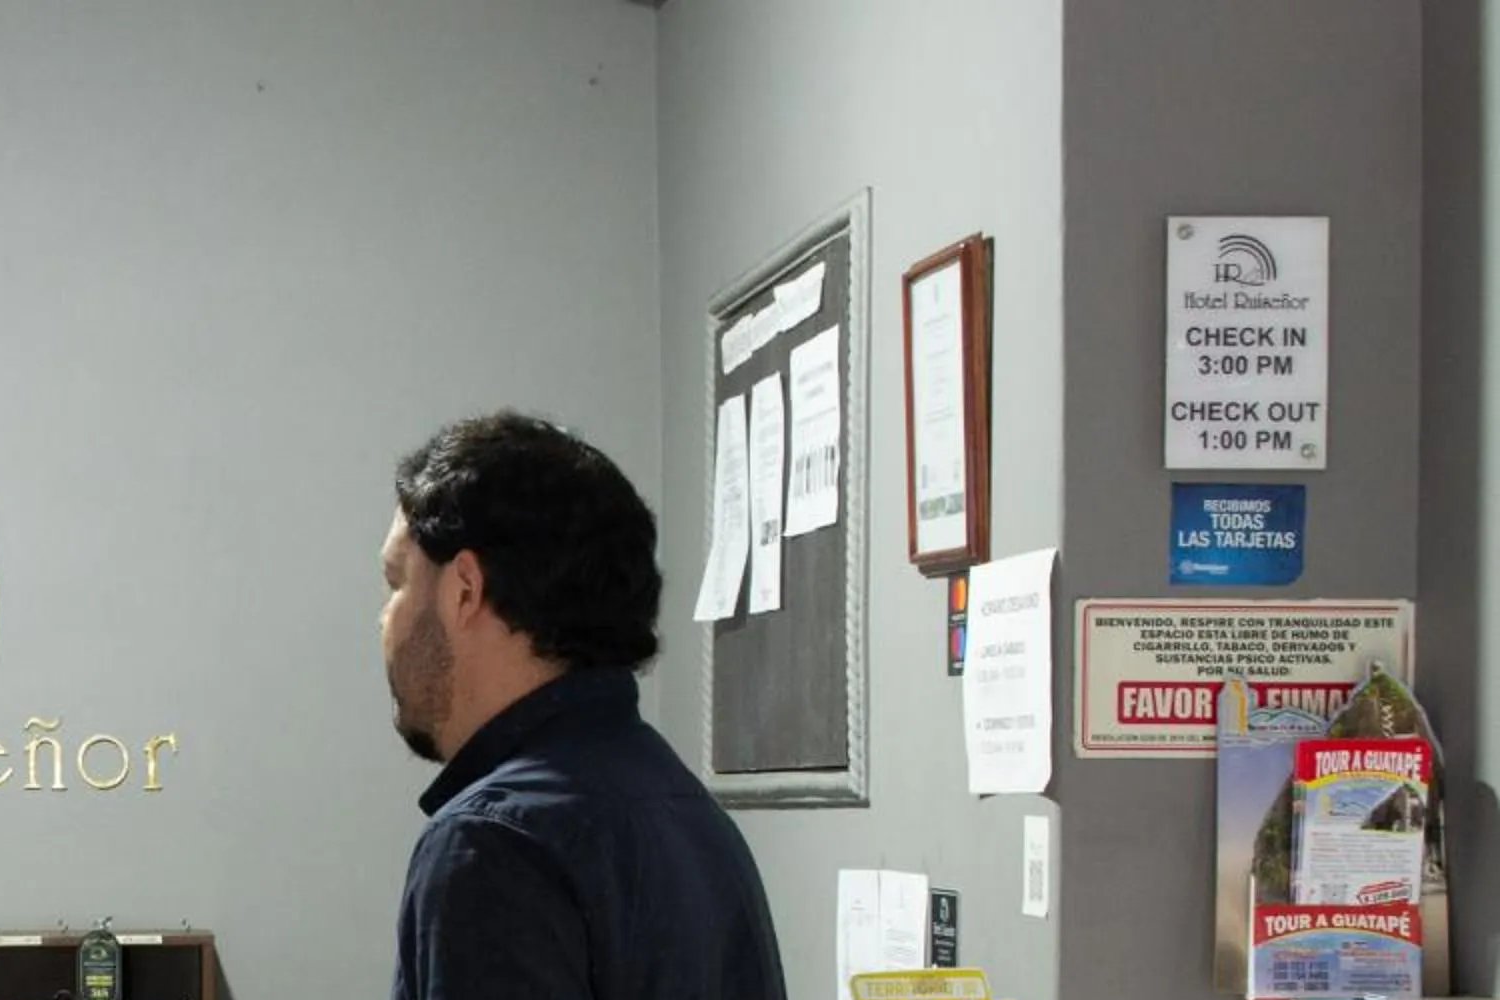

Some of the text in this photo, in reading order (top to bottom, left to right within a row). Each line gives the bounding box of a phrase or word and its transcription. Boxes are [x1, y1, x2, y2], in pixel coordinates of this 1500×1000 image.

[1185, 292, 1310, 310] Hotel Ruiseñor
[1186, 327, 1307, 347] CHECK IN
[1198, 356, 1293, 375] 3:00 PM
[1171, 402, 1320, 422] CHECK OUT
[1199, 431, 1292, 450] 1:00 PM
[1210, 513, 1265, 530] TODAS
[1177, 530, 1296, 549] LAS TARJETAS
[1180, 617, 1234, 628] RESPIRE
[1238, 618, 1265, 628] CON
[1268, 617, 1361, 628] TRANQUILIDAD
[1364, 618, 1395, 628] ESTE
[1140, 629, 1349, 640] ESPACIO ESTA LIBRE DE HUMO DE
[1272, 641, 1345, 652] DERIVADOS
[1348, 642, 1357, 652] Y
[1156, 653, 1233, 664] SUSTANCIAS
[1237, 653, 1275, 664] PSICO
[1197, 666, 1223, 676] POR
[1122, 687, 1213, 719] FAVOR
[1267, 688, 1353, 720] FUMA
[1315, 746, 1424, 781] TOUR A GUATAPÉ
[1264, 911, 1411, 937] TOUR A GUATAPÉ
